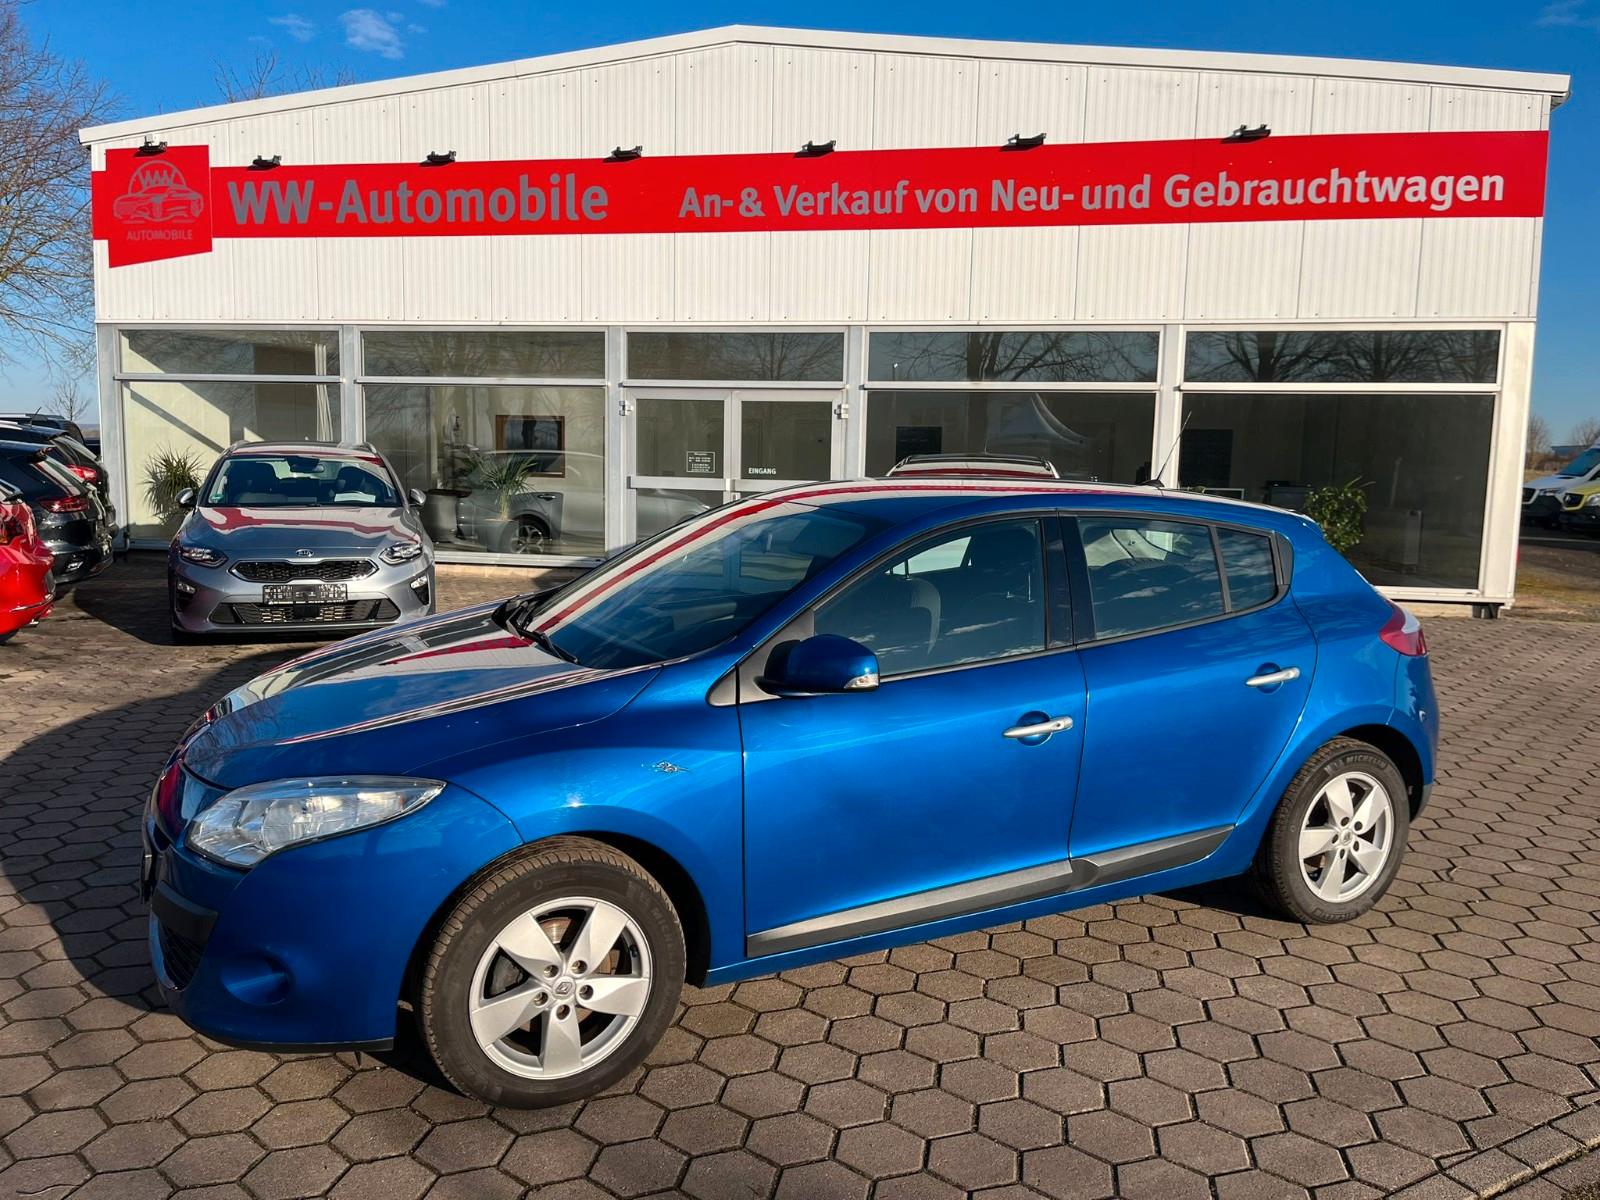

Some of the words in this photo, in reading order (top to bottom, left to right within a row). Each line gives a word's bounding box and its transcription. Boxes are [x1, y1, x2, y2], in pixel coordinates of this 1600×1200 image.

[228, 173, 608, 225] WW-Automobile
[773, 181, 909, 217] Verkauf
[914, 188, 978, 213] von
[1163, 167, 1505, 211] Gebrauchtwagen
[127, 229, 193, 241] AUTOMOBILE
[748, 467, 777, 475] EINGANG
